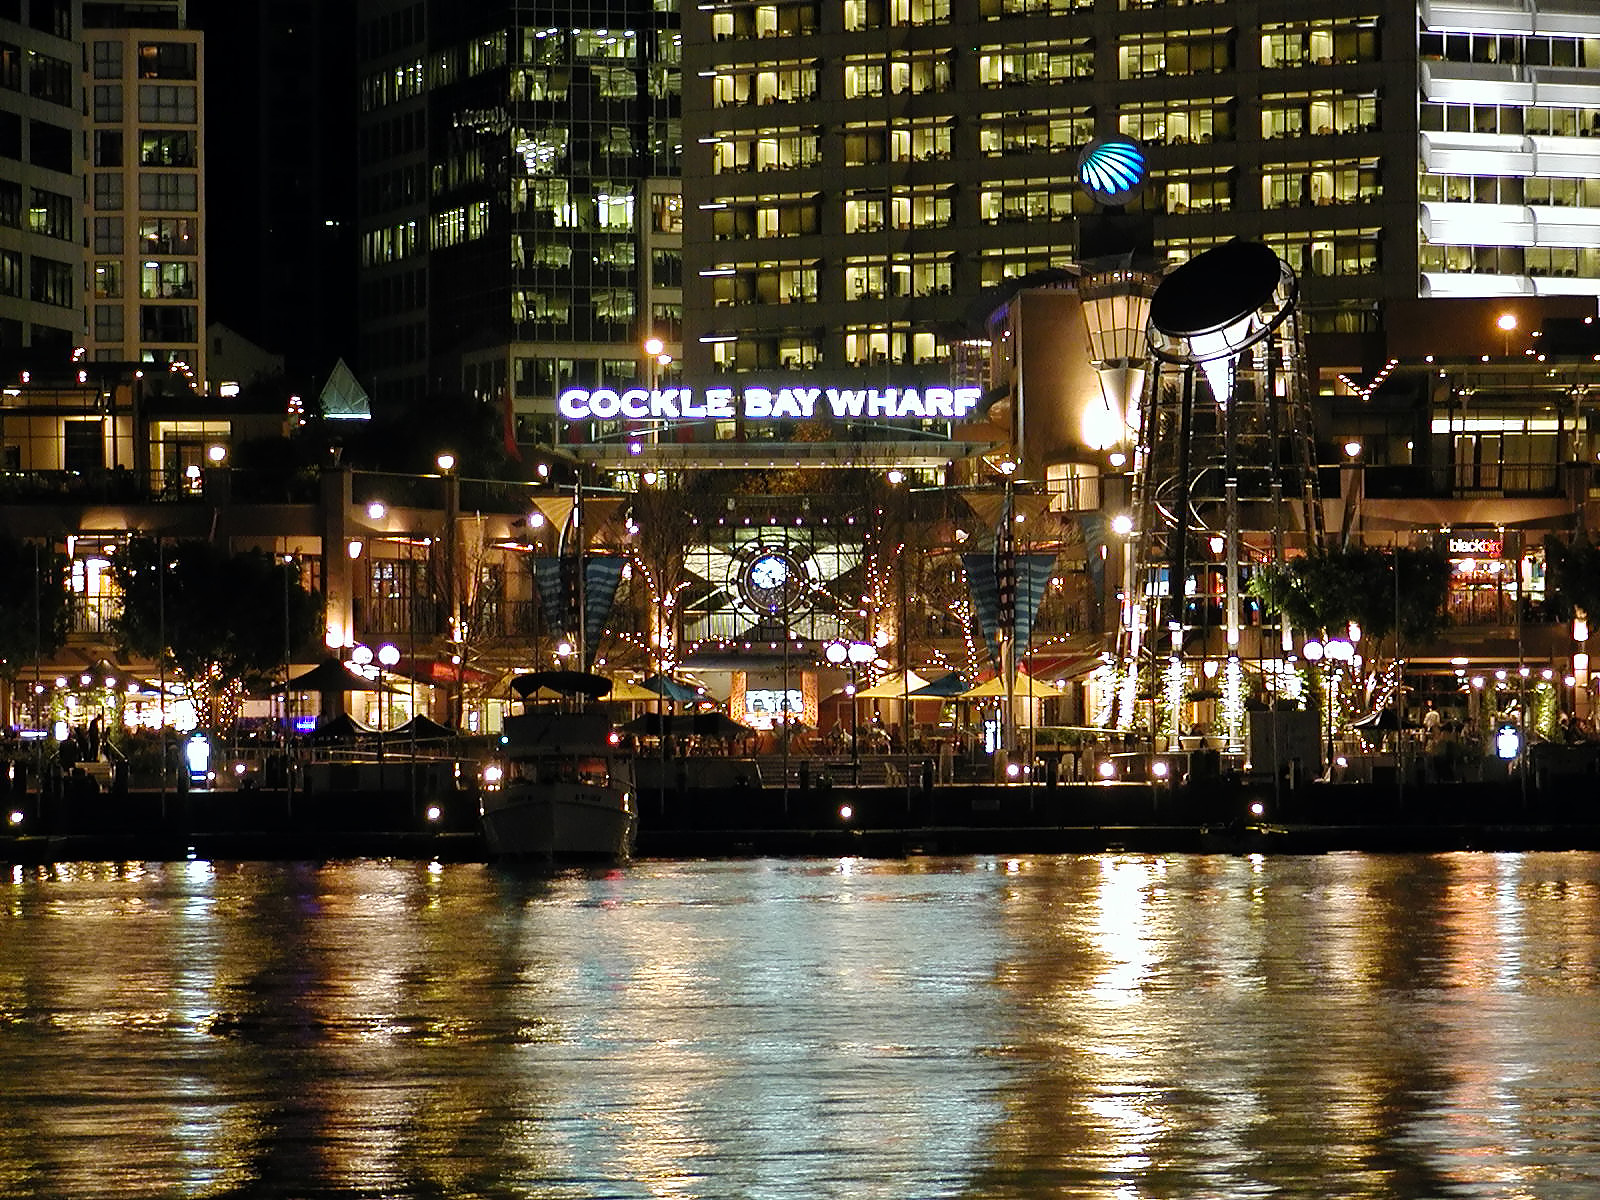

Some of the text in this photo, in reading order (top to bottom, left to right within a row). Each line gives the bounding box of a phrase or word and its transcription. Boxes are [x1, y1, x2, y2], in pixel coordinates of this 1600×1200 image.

[558, 388, 982, 419] COCKLE BAY WHARF
